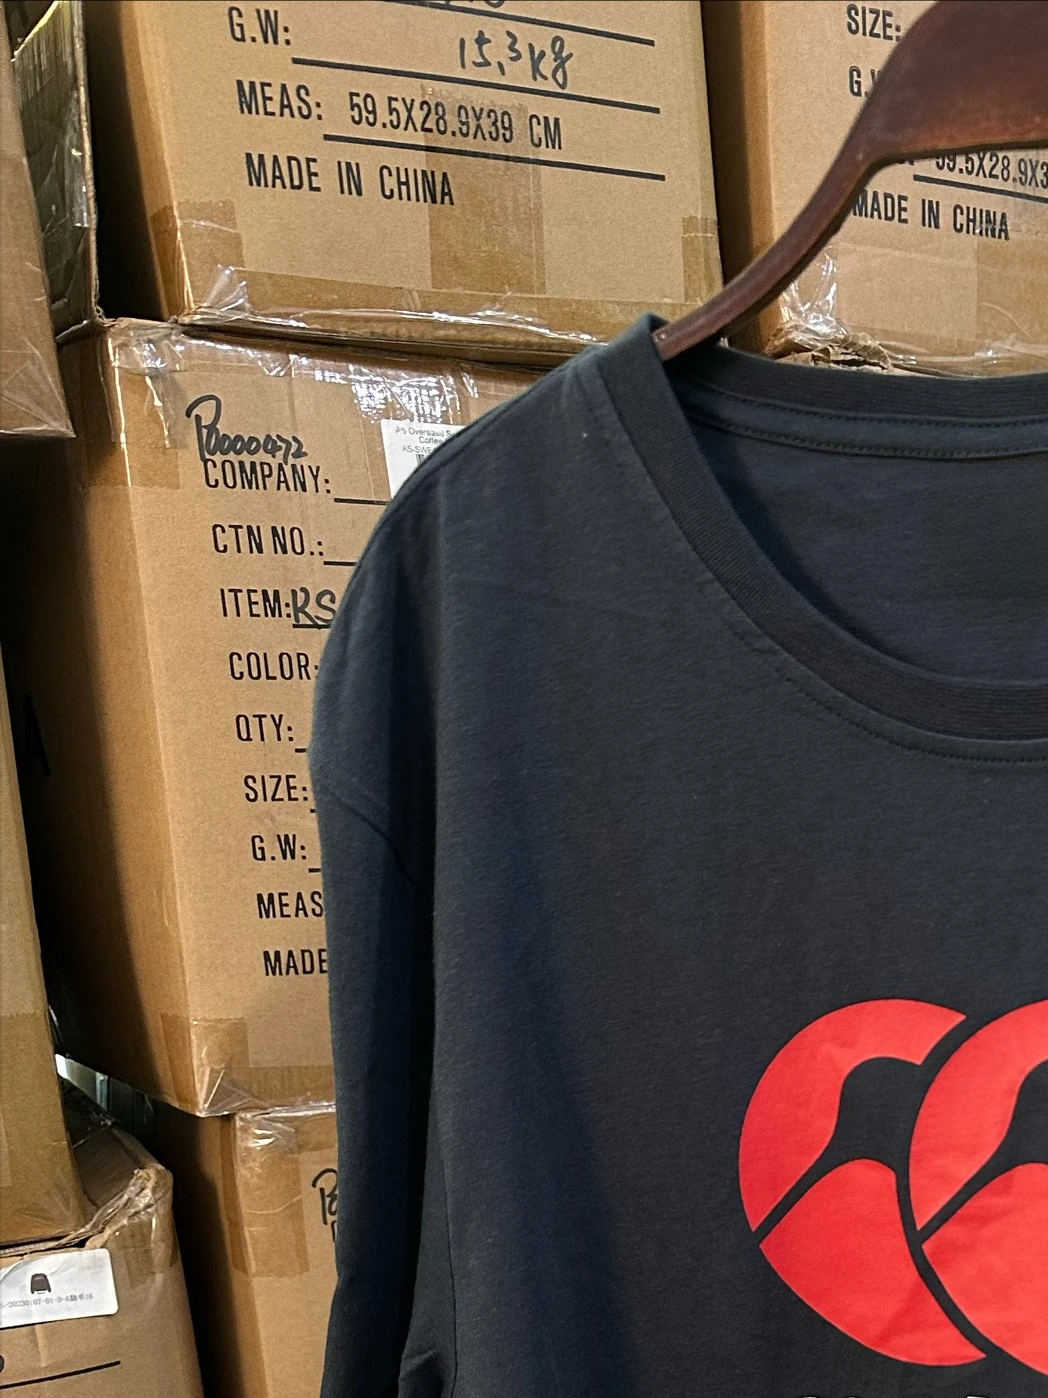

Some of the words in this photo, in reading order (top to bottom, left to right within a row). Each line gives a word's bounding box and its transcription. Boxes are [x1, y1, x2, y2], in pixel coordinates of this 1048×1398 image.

[228, 7, 292, 46] G.W:
[235, 80, 323, 121] MEAS:
[349, 92, 514, 144] 59.5X28.9X39
[529, 116, 562, 150] CM
[245, 153, 321, 193] MADE
[337, 160, 362, 197] IN
[379, 165, 454, 206] CHINA
[853, 189, 909, 224] MADE
[921, 199, 940, 229] IN
[953, 204, 1010, 241] CHINA
[203, 458, 331, 494] COMPANY:
[212, 524, 264, 555] CTN
[271, 526, 324, 556] NO.:
[220, 588, 292, 618] ITEM:
[235, 714, 294, 742] QTY:
[243, 774, 308, 803] SIZE:
[251, 833, 307, 862] G.W:
[263, 948, 329, 976] MADE
